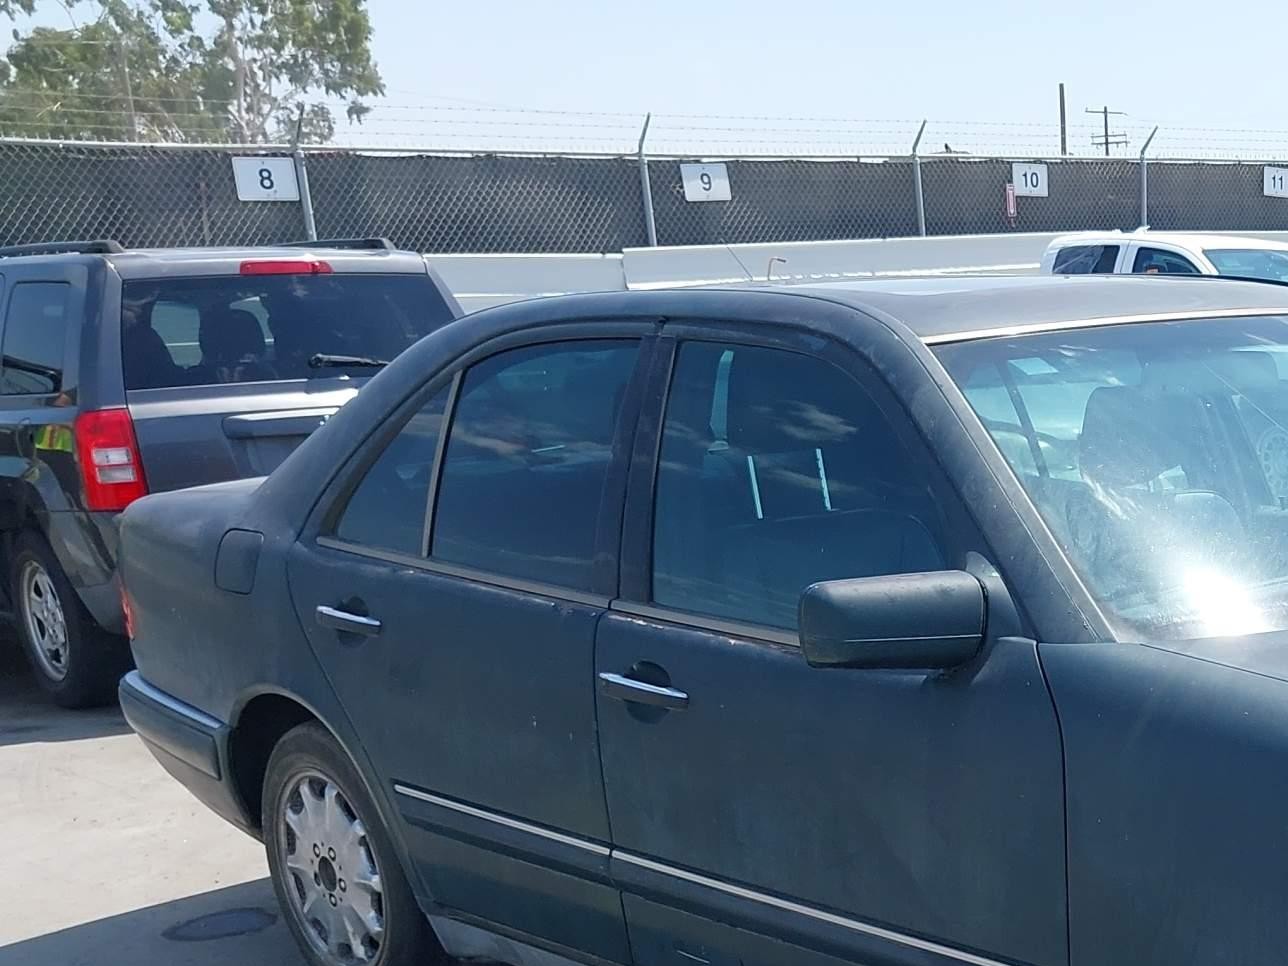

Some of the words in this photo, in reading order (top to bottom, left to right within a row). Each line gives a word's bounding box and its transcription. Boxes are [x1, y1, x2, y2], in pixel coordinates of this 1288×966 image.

[258, 168, 274, 190] 8
[700, 173, 712, 191] 9
[1022, 171, 1039, 188] 10
[1272, 175, 1283, 190] 11
